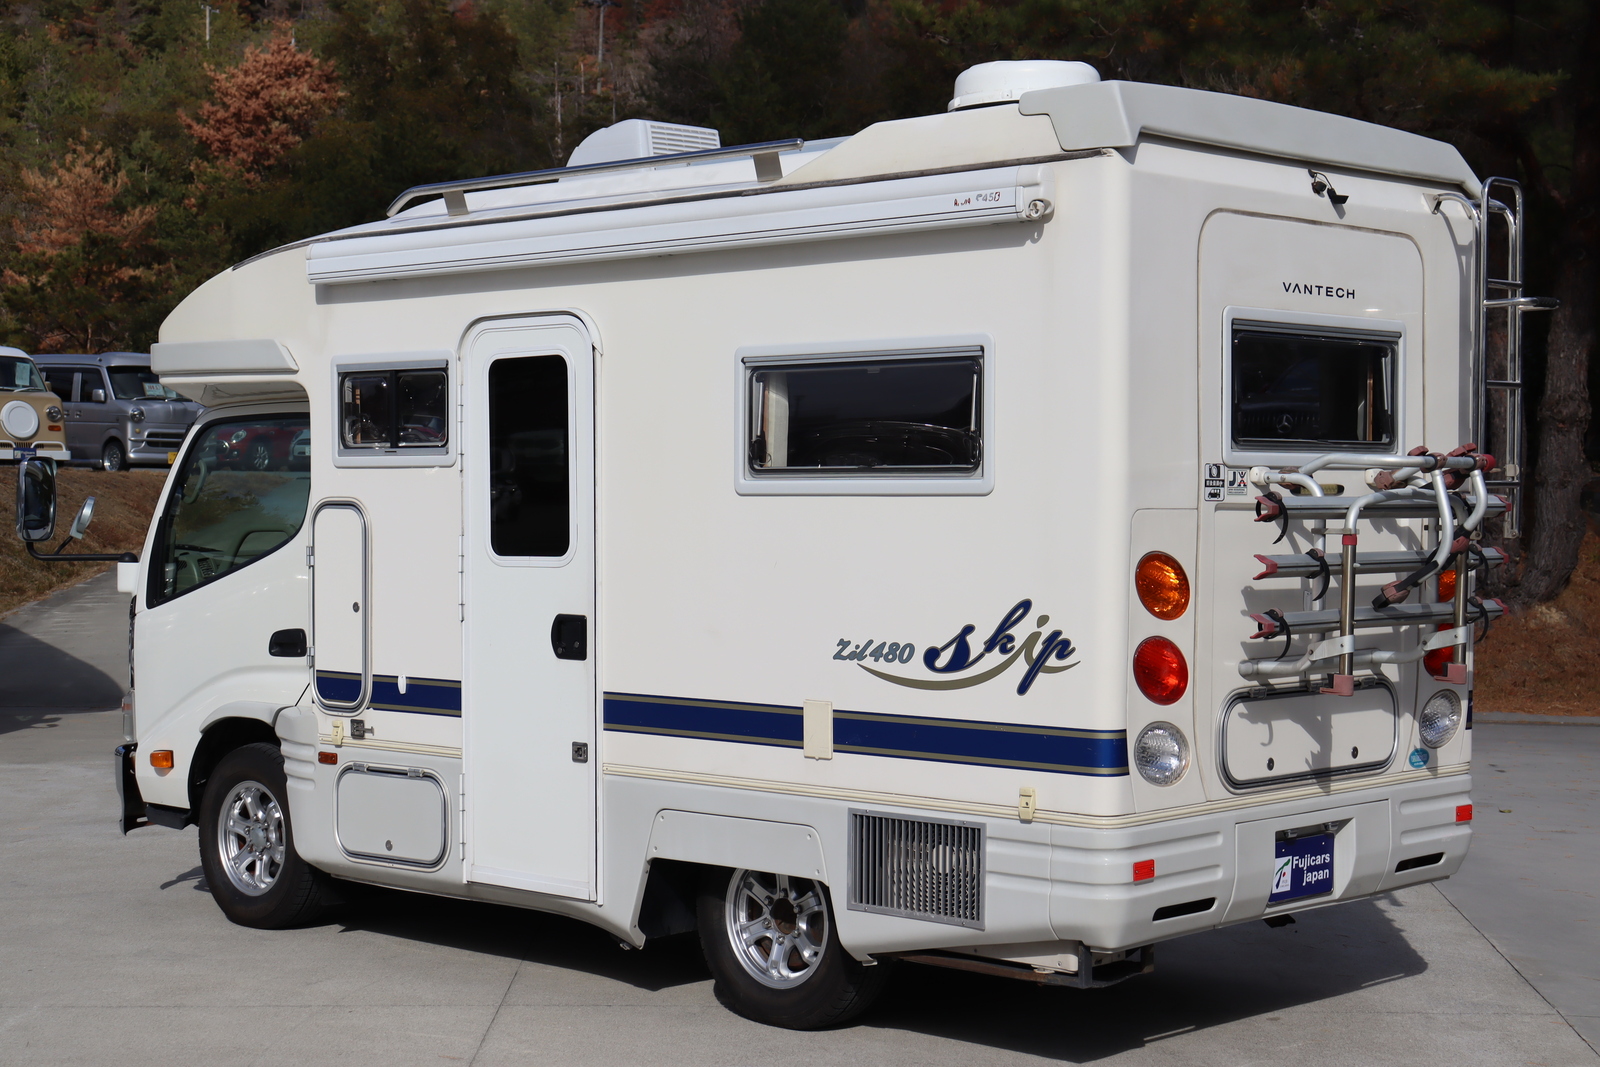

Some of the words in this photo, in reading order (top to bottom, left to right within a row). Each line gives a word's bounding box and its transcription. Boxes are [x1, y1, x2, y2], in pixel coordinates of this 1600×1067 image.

[1282, 281, 1355, 299] VANTECH
[1292, 853, 1330, 870] Fujicars
[1302, 868, 1329, 886] japan
